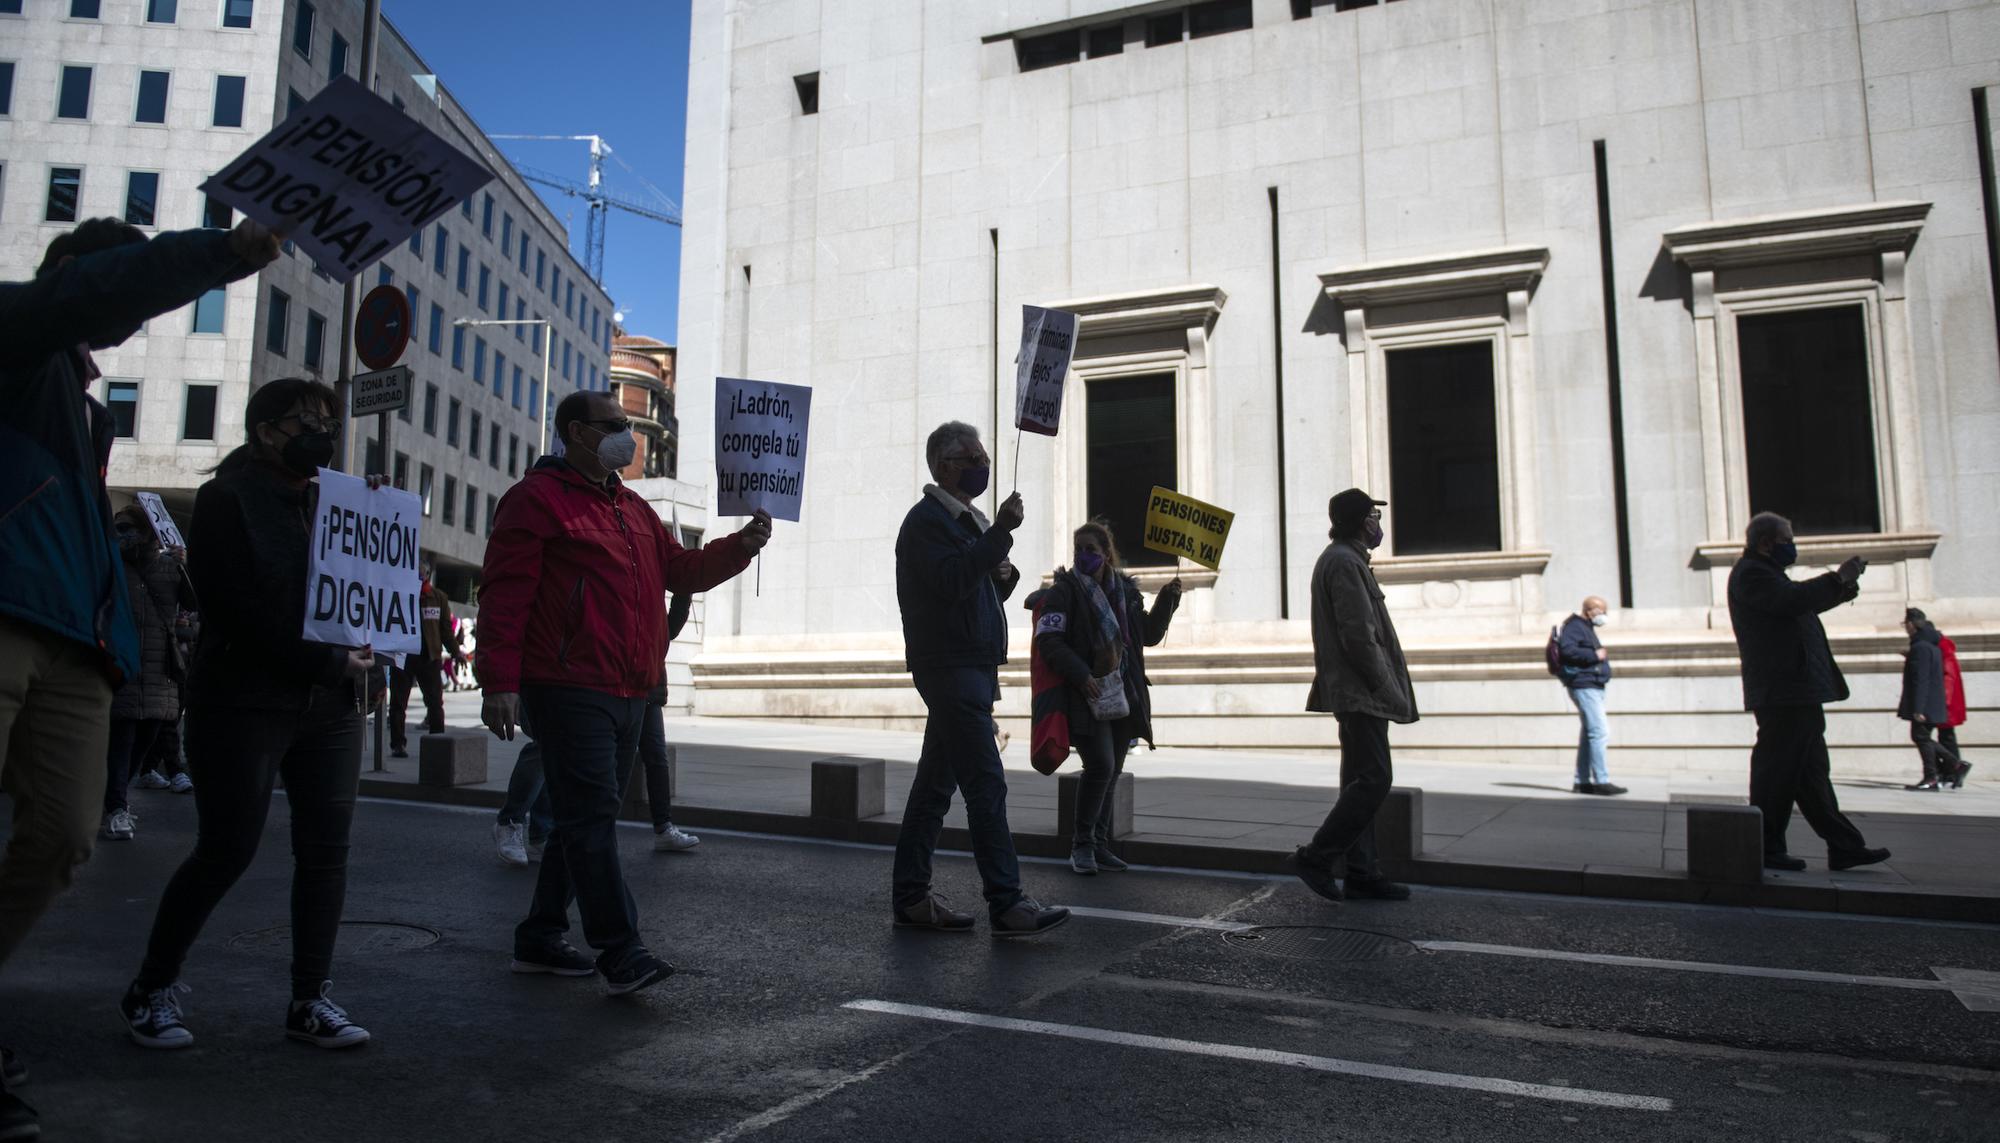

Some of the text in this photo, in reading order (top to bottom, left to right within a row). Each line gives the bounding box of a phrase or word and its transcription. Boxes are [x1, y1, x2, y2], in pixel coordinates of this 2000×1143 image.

[270, 114, 455, 228] ¡PENSIÓN
[222, 155, 390, 271] DIGNA!
[356, 390, 402, 408] SEGURIDAD
[361, 375, 397, 392] ZONA DE
[730, 388, 793, 423] ¡Ladrón,
[721, 429, 800, 460] congela tú
[720, 468, 801, 499] tu pensión!
[1151, 495, 1227, 535] PENSIONES
[320, 504, 417, 570] ¡PENSIÓN
[1147, 524, 1219, 563] JUSTAS, YA!
[314, 573, 417, 635] DIGNA!
